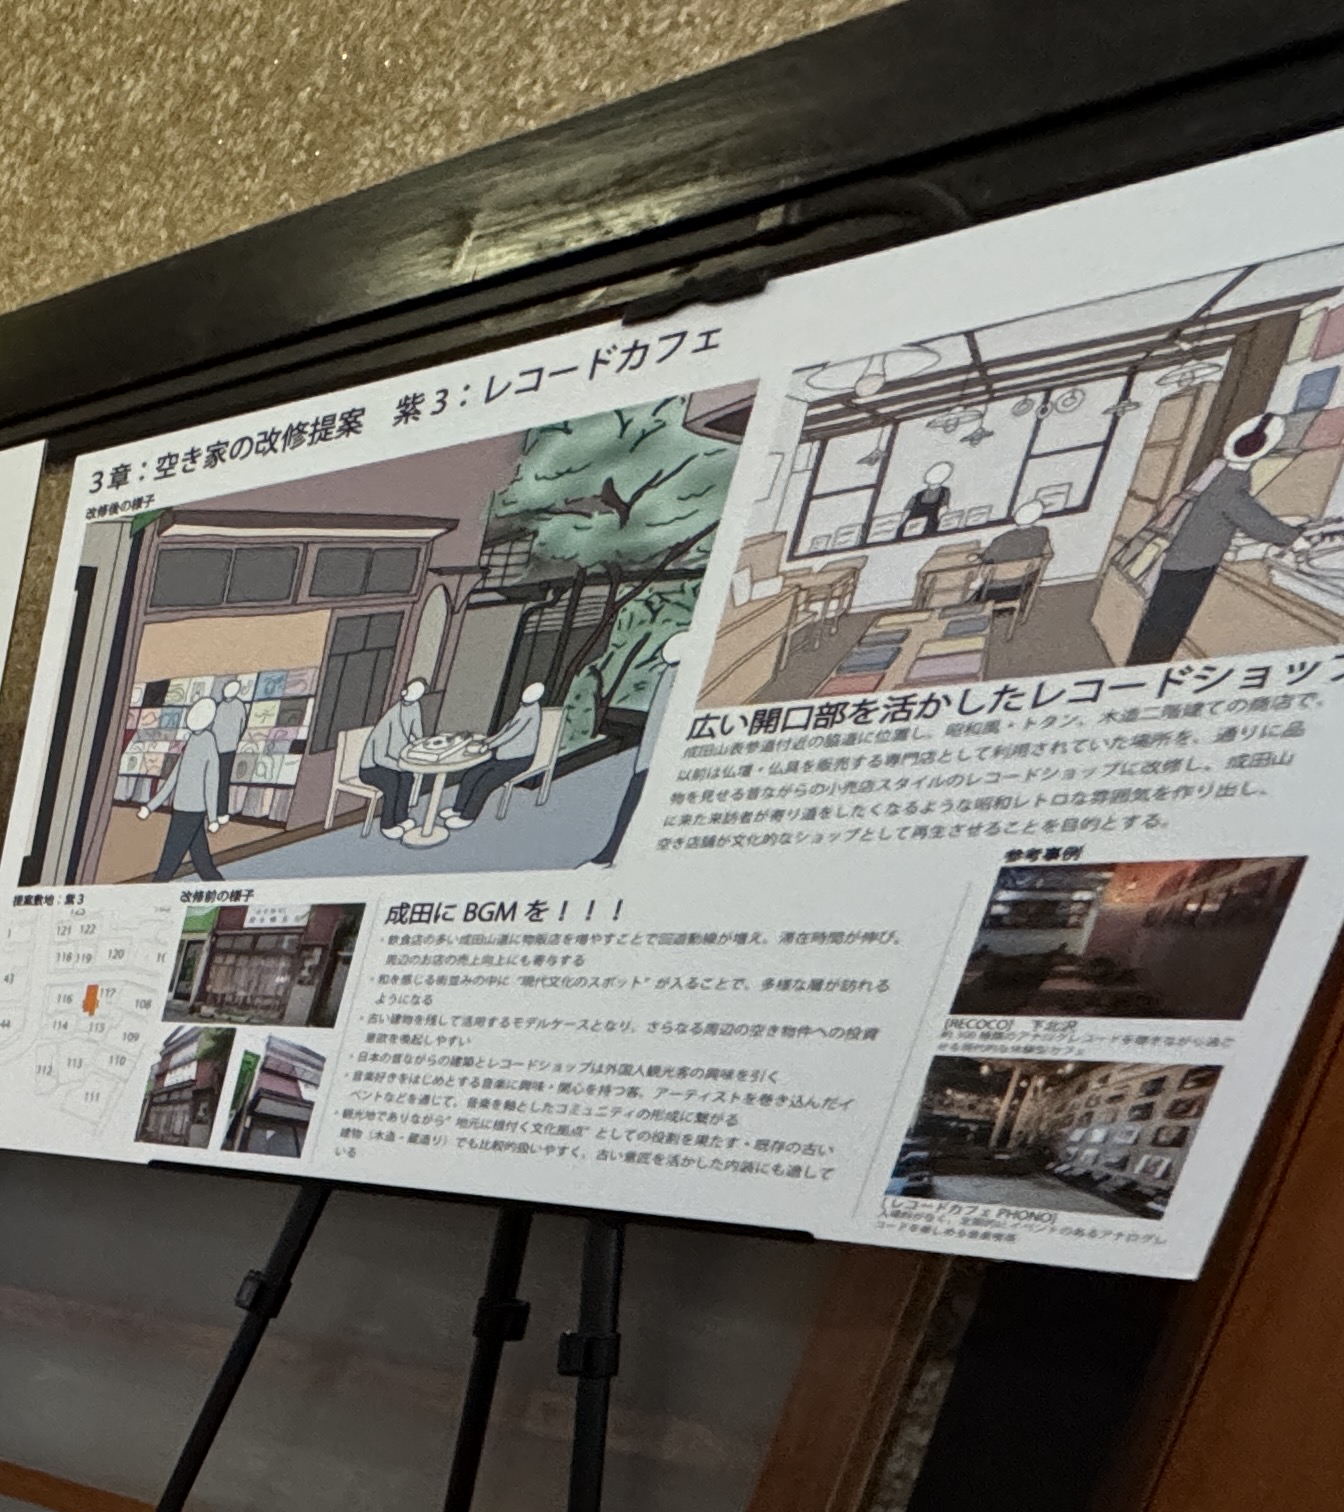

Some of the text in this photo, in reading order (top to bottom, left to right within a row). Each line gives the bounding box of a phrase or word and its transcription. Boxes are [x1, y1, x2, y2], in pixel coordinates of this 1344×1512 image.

[84, 493, 157, 520] 改修後の様子
[1003, 843, 1087, 862] 参考事例
[180, 888, 255, 903] 改修前の様子
[374, 994, 433, 1006] ようになる
[334, 1147, 357, 1158] いる
